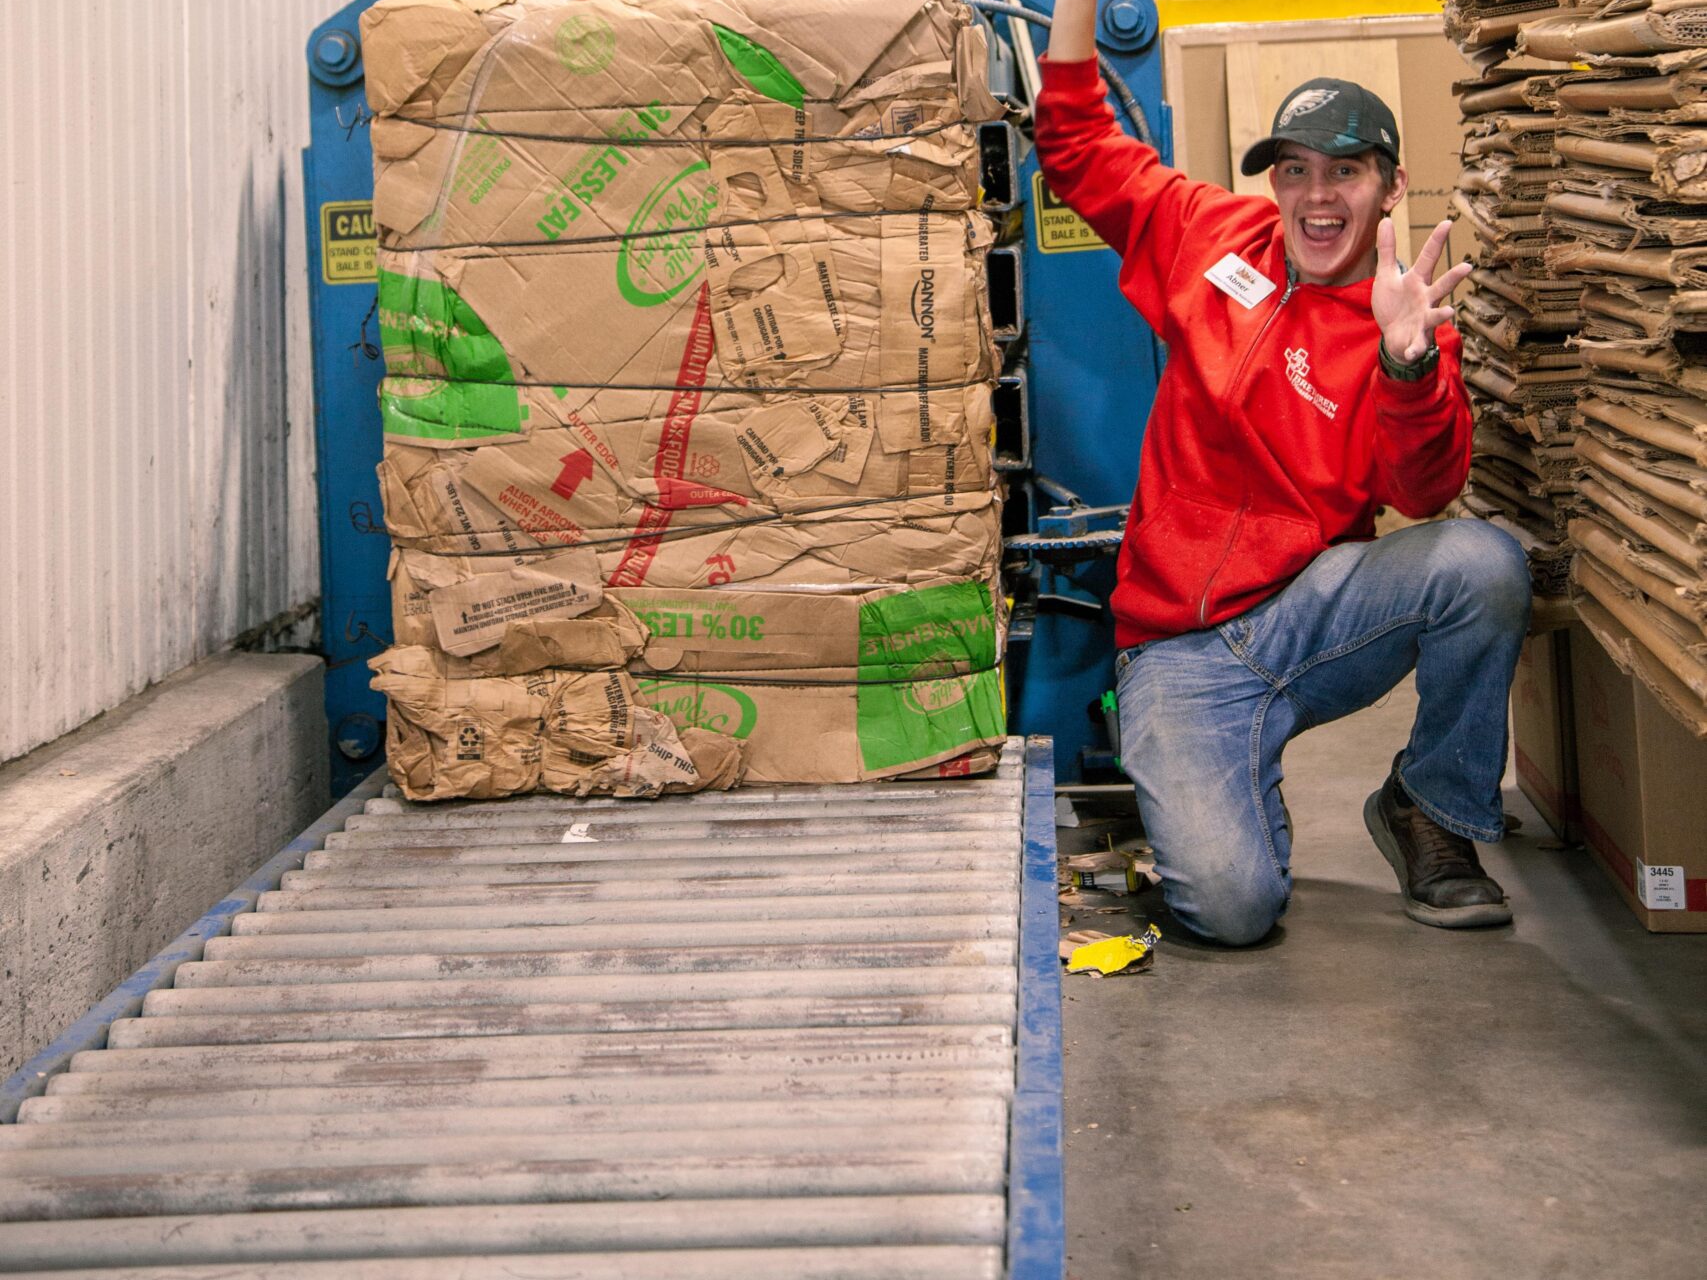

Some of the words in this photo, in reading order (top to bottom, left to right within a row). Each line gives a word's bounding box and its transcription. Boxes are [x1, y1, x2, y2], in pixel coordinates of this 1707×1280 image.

[794, 128, 805, 147] THS
[793, 150, 804, 170] SIDE
[571, 145, 629, 205] LESS
[536, 195, 581, 240] FAT
[1044, 215, 1075, 226] STAND
[918, 209, 929, 261] FRIGERATED
[1051, 229, 1075, 240] BALE
[1080, 228, 1089, 238] IS
[329, 246, 359, 256] STAND
[336, 261, 359, 272] BALE
[1226, 274, 1249, 292] Abner
[921, 269, 934, 339] DANNON
[753, 307, 771, 346] CORRUGADO
[764, 304, 780, 340] CANTIDAD
[774, 338, 784, 350] POR
[567, 412, 598, 445] OUTER
[594, 442, 619, 470] EDGE
[745, 428, 768, 455] CANTIDAD
[767, 452, 779, 465] POR
[453, 499, 465, 517] 22.6
[499, 492, 531, 518] WHEN
[505, 484, 540, 509] ALIGN
[540, 505, 585, 538] ARROWS
[482, 600, 495, 611] NOT
[495, 596, 516, 607] STACK
[615, 730, 625, 748] LAD
[649, 743, 672, 762] SHIP
[673, 757, 695, 776] THIS
[1650, 867, 1674, 877] 3445
